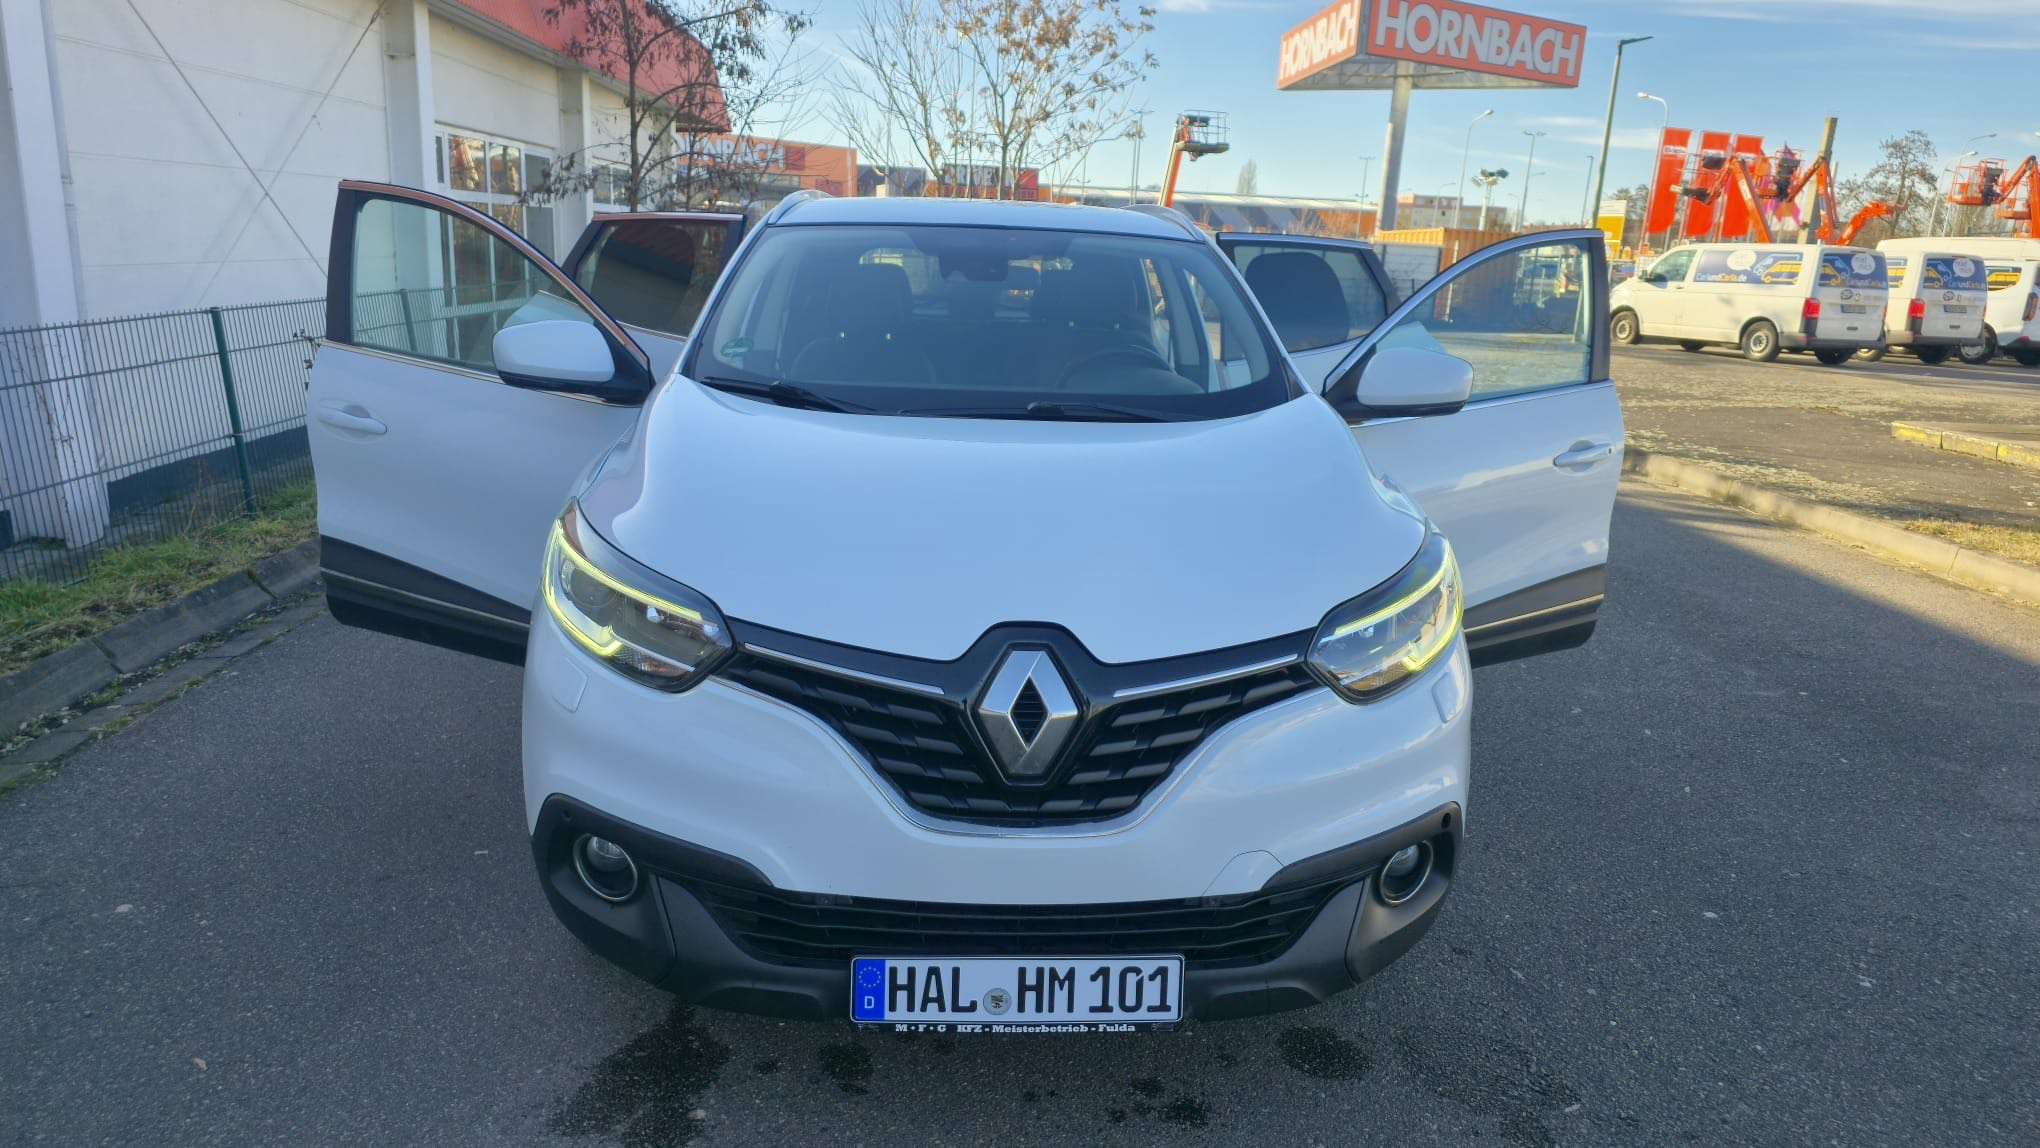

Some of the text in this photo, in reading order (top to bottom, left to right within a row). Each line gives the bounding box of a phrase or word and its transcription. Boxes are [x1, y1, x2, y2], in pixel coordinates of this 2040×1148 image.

[1280, 2, 1357, 80] HORNBACH
[1376, 0, 1580, 77] HORNBACH
[863, 995, 876, 1009] D
[888, 966, 1171, 1013] HAL HM 101
[1098, 1024, 1135, 1032] Fulda
